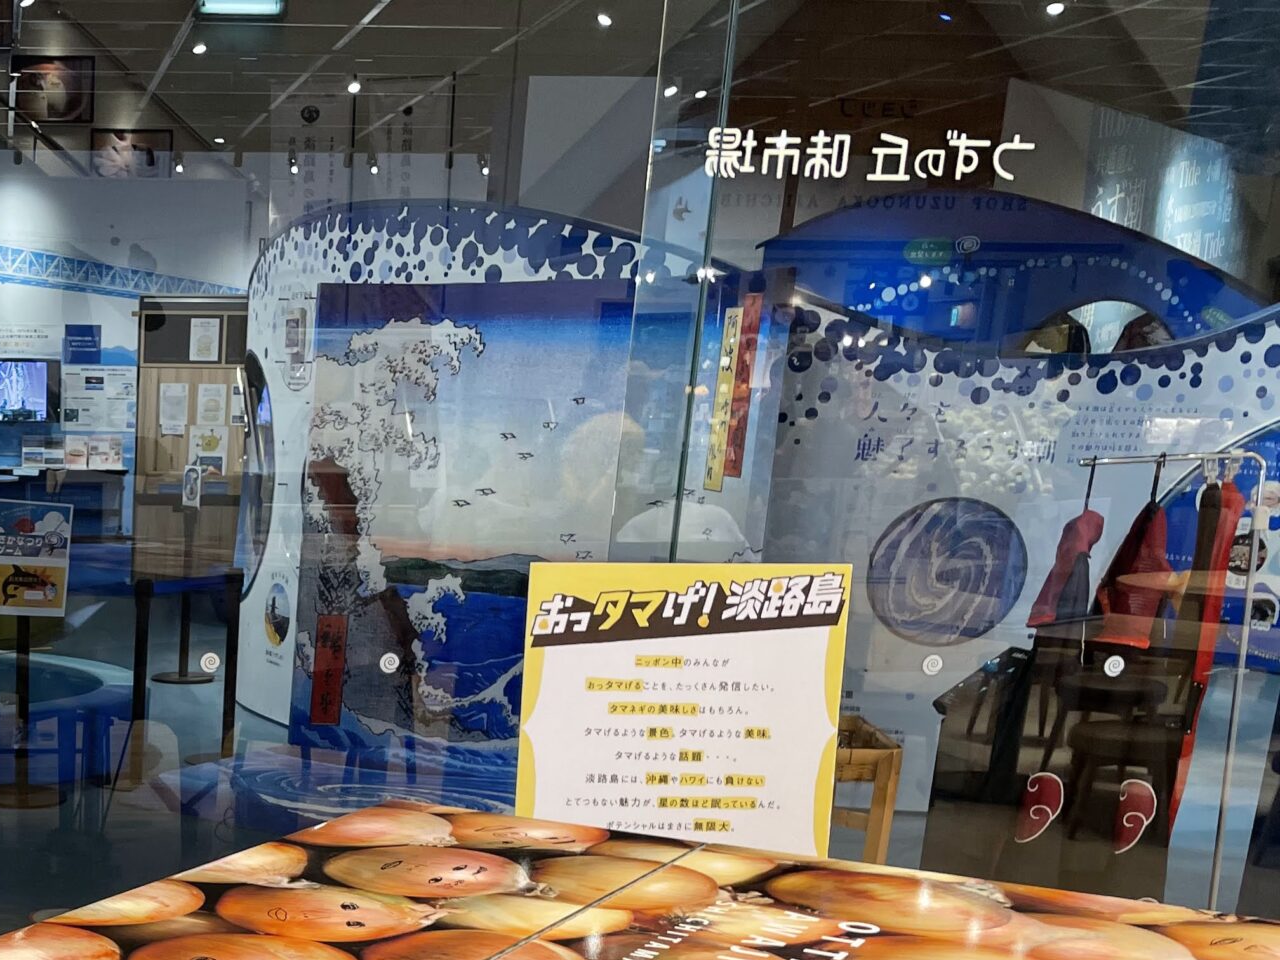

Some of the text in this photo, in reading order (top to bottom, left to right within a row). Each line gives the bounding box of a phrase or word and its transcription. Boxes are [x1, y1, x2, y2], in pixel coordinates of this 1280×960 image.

[635, 656, 731, 669] ニッポン中のみんなが
[609, 703, 750, 716] タマネギの美味しさはもちろん。
[585, 773, 766, 786] 淡路島には、沖縄やハワイにも負けない
